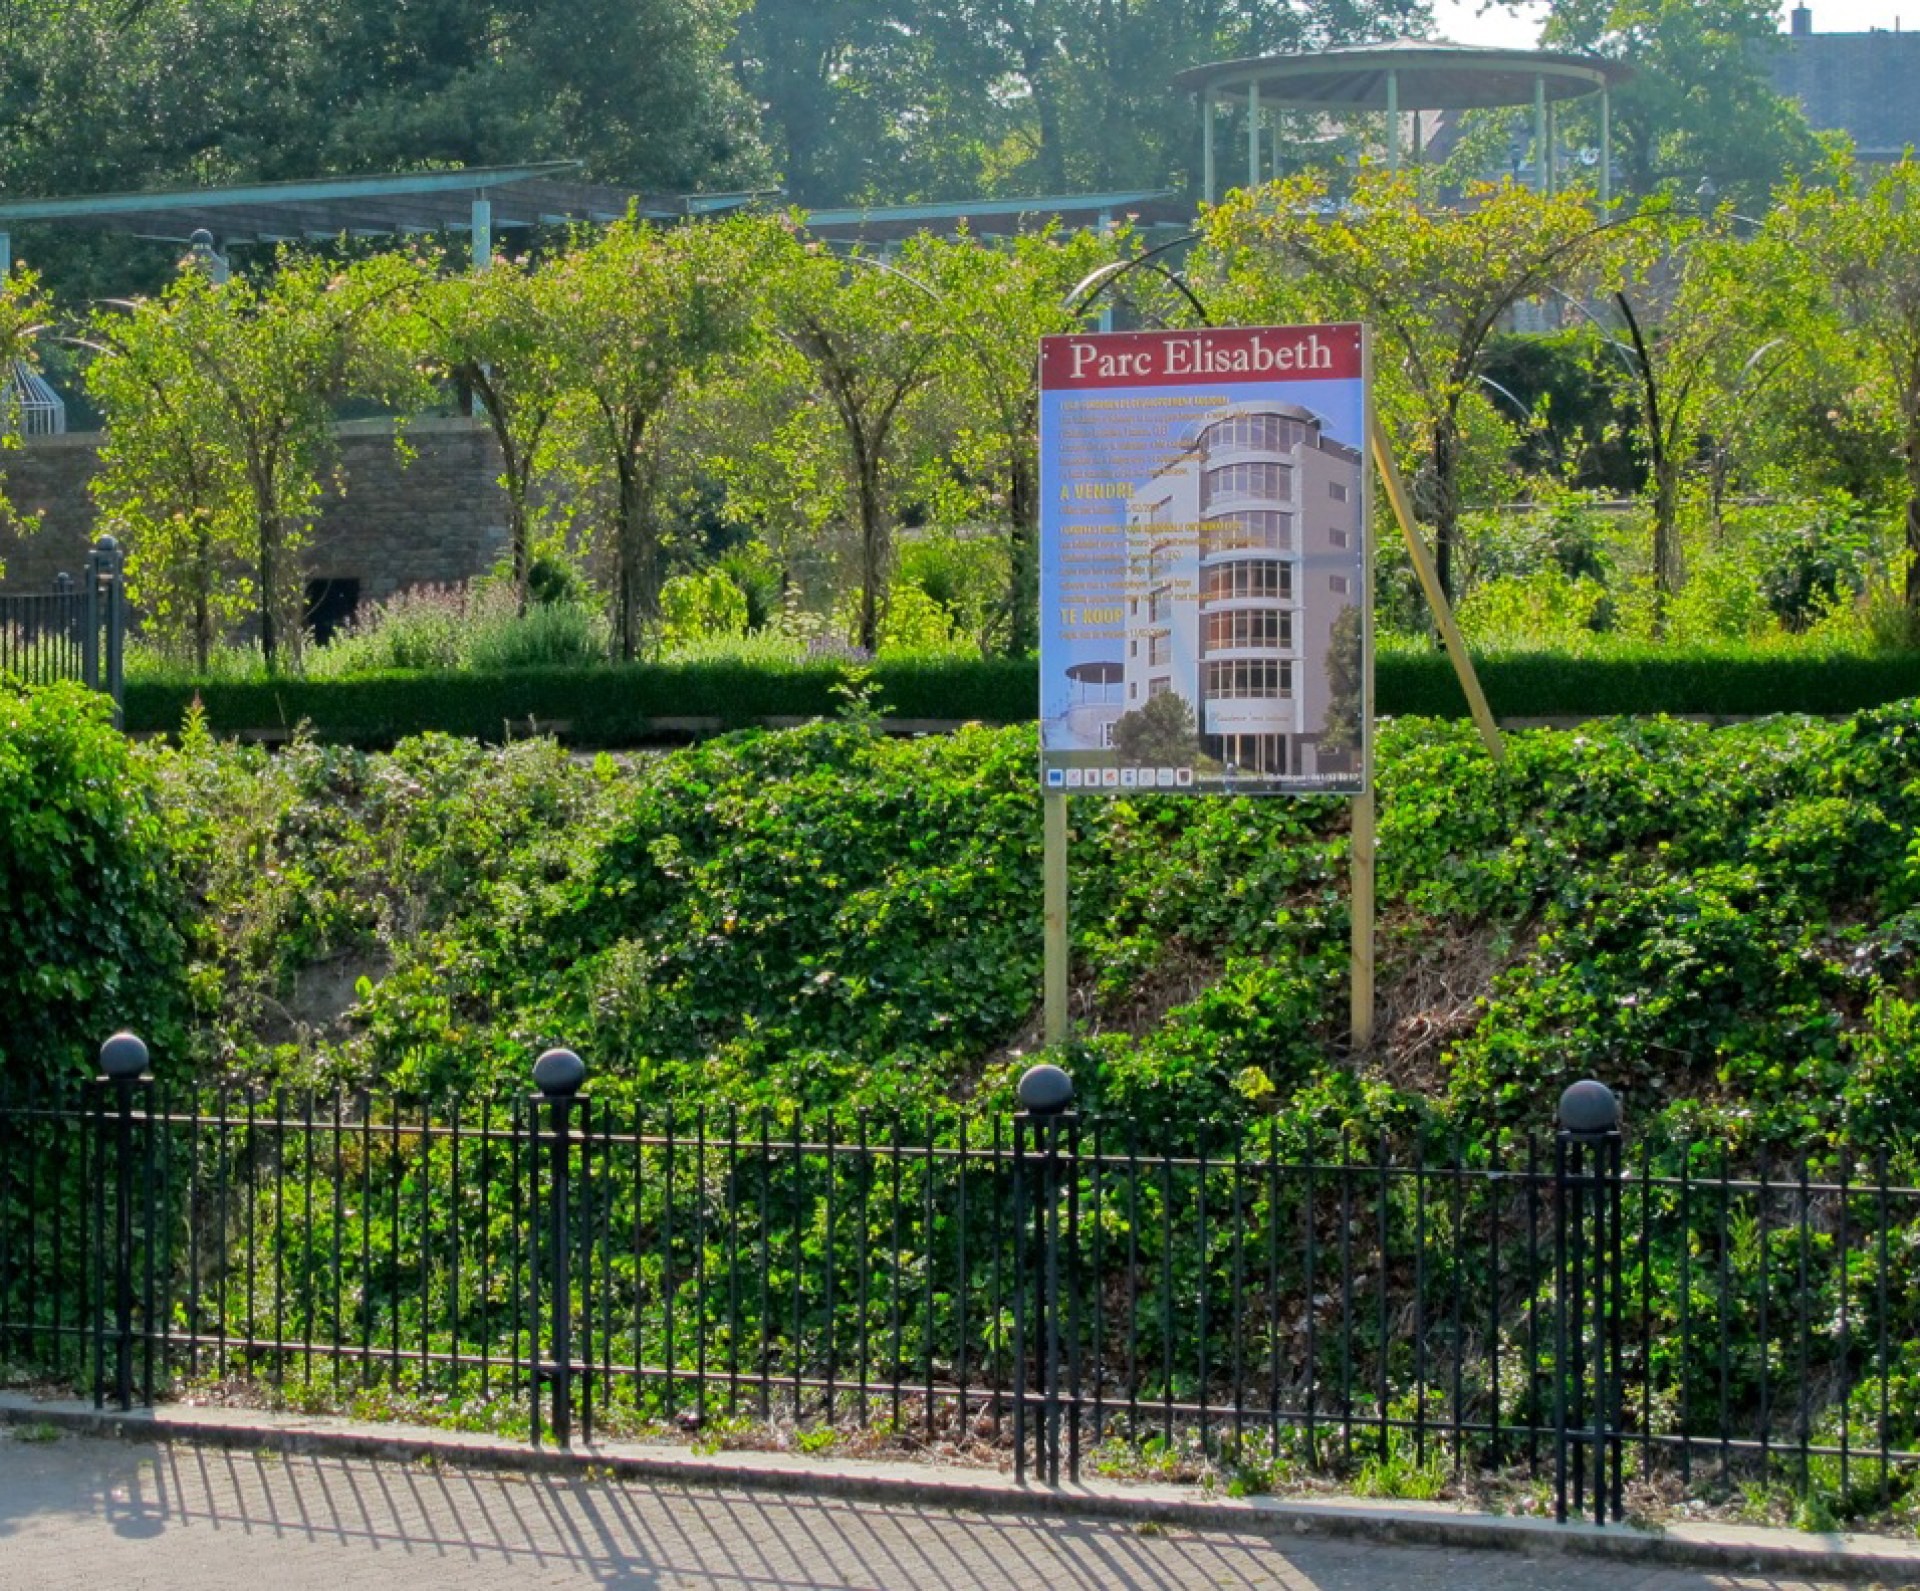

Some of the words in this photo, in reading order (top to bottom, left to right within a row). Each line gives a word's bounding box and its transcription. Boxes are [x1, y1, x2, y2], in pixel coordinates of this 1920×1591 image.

[1069, 343, 1152, 379] Parc
[1162, 334, 1333, 375] Elisabeth
[1074, 482, 1136, 499] VENDRE
[1060, 608, 1076, 625] TE
[1082, 608, 1124, 625] KOOP
